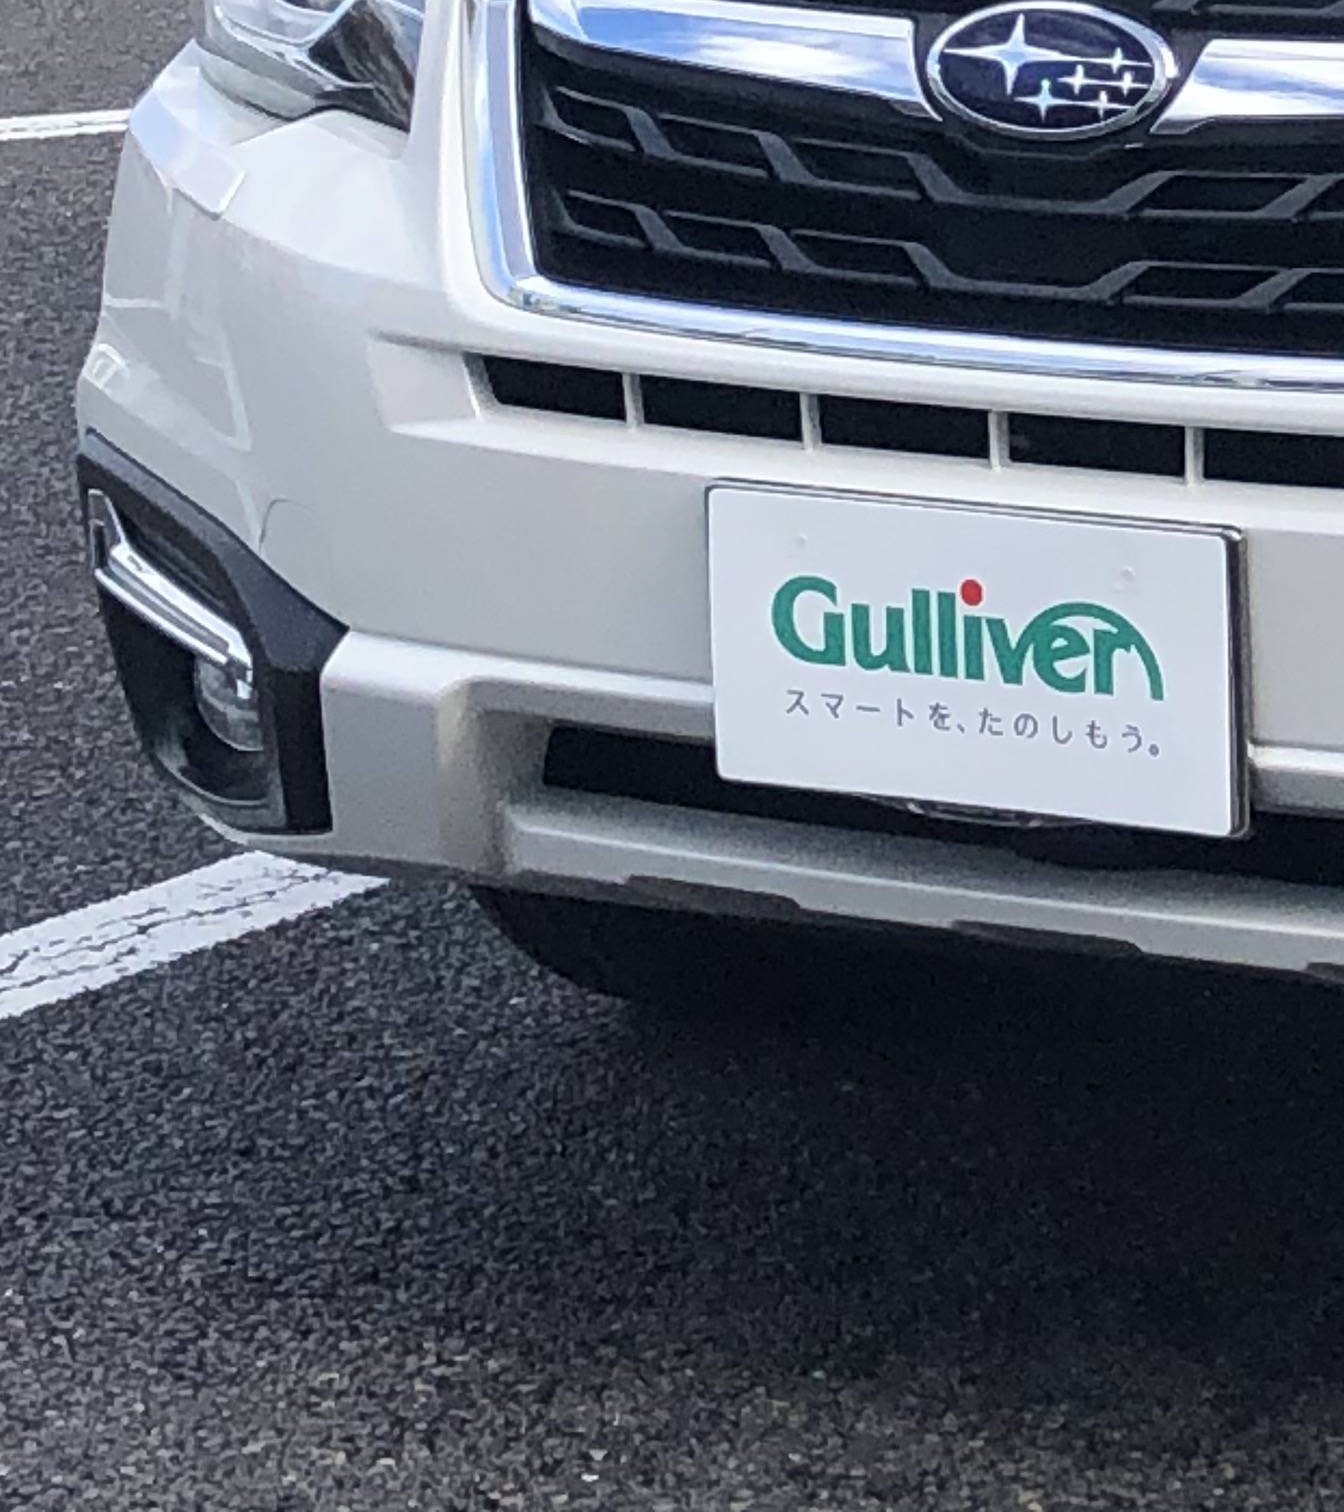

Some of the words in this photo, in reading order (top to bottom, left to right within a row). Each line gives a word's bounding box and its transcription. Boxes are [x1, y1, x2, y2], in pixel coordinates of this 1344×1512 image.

[772, 576, 1163, 701] Gulliver
[785, 690, 1159, 756] スマートを、たのしもう。
